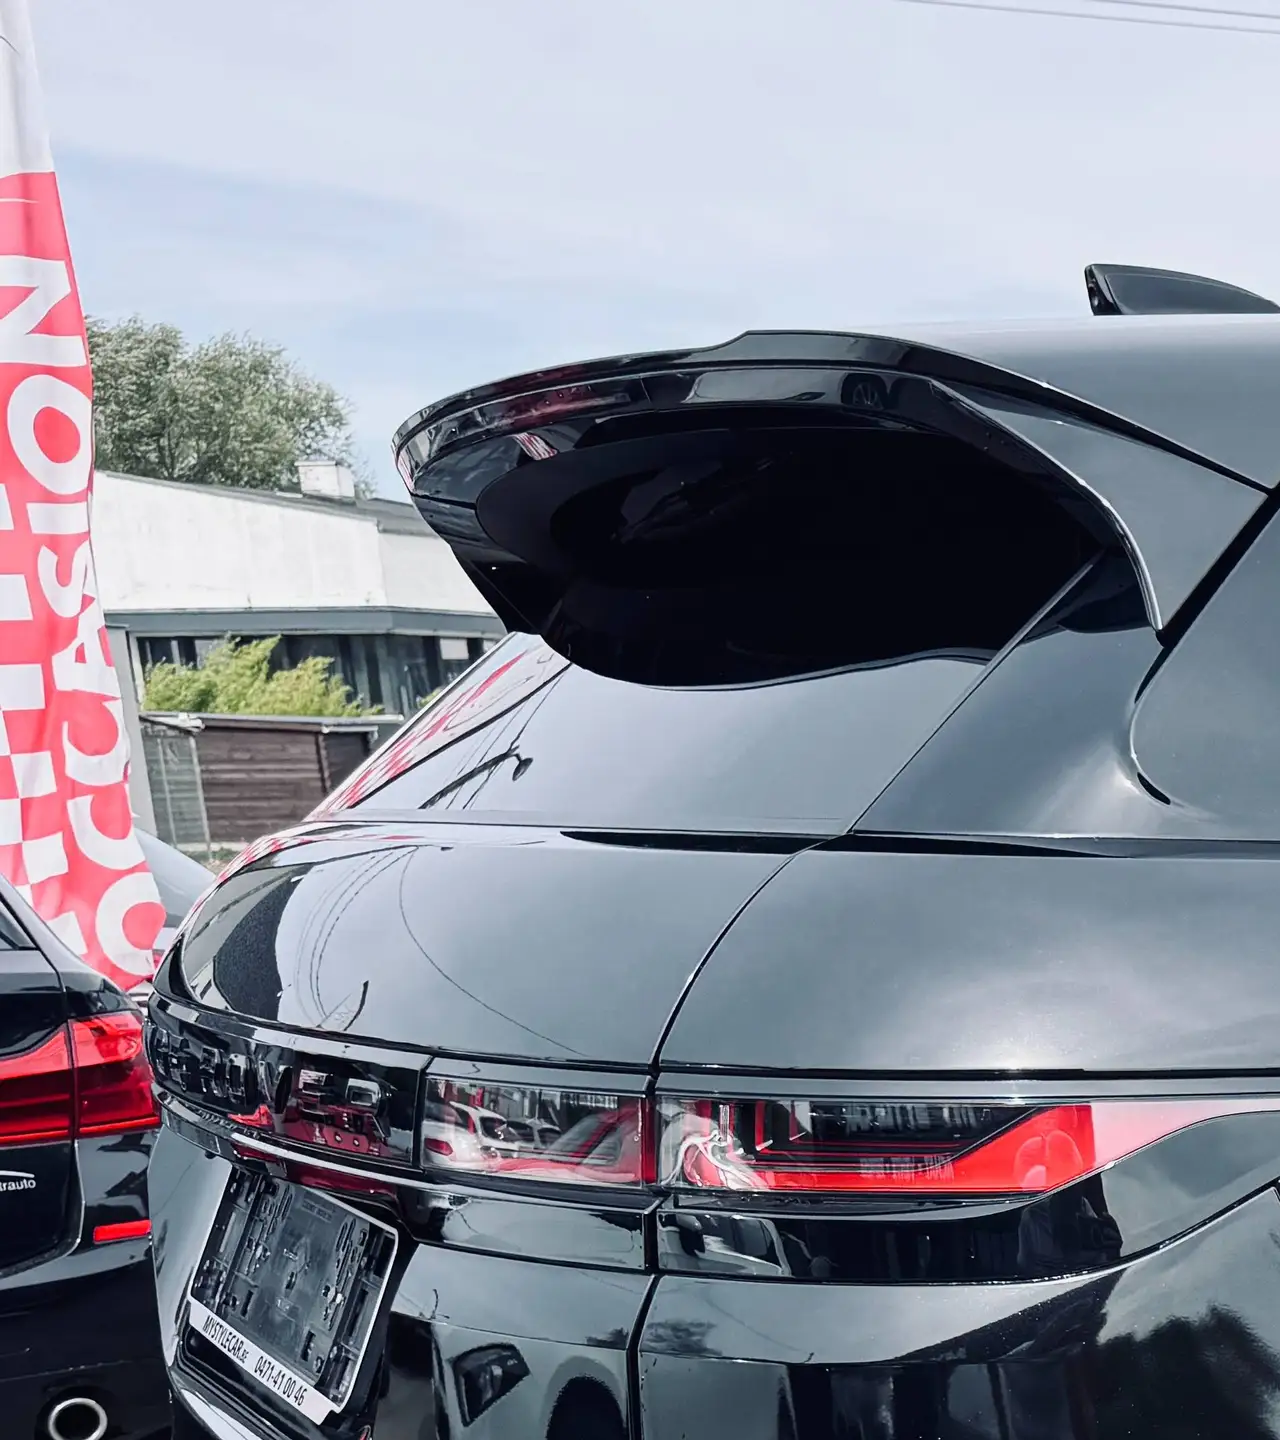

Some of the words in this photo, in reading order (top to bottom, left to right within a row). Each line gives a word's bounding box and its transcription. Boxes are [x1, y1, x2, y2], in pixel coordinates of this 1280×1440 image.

[0, 254, 167, 978] OCCASION
[202, 1314, 249, 1364] MYSTYLECAR.BE
[254, 1357, 283, 1390] 0471-41
[282, 1379, 296, 1398] 00
[293, 1388, 306, 1406] 46
